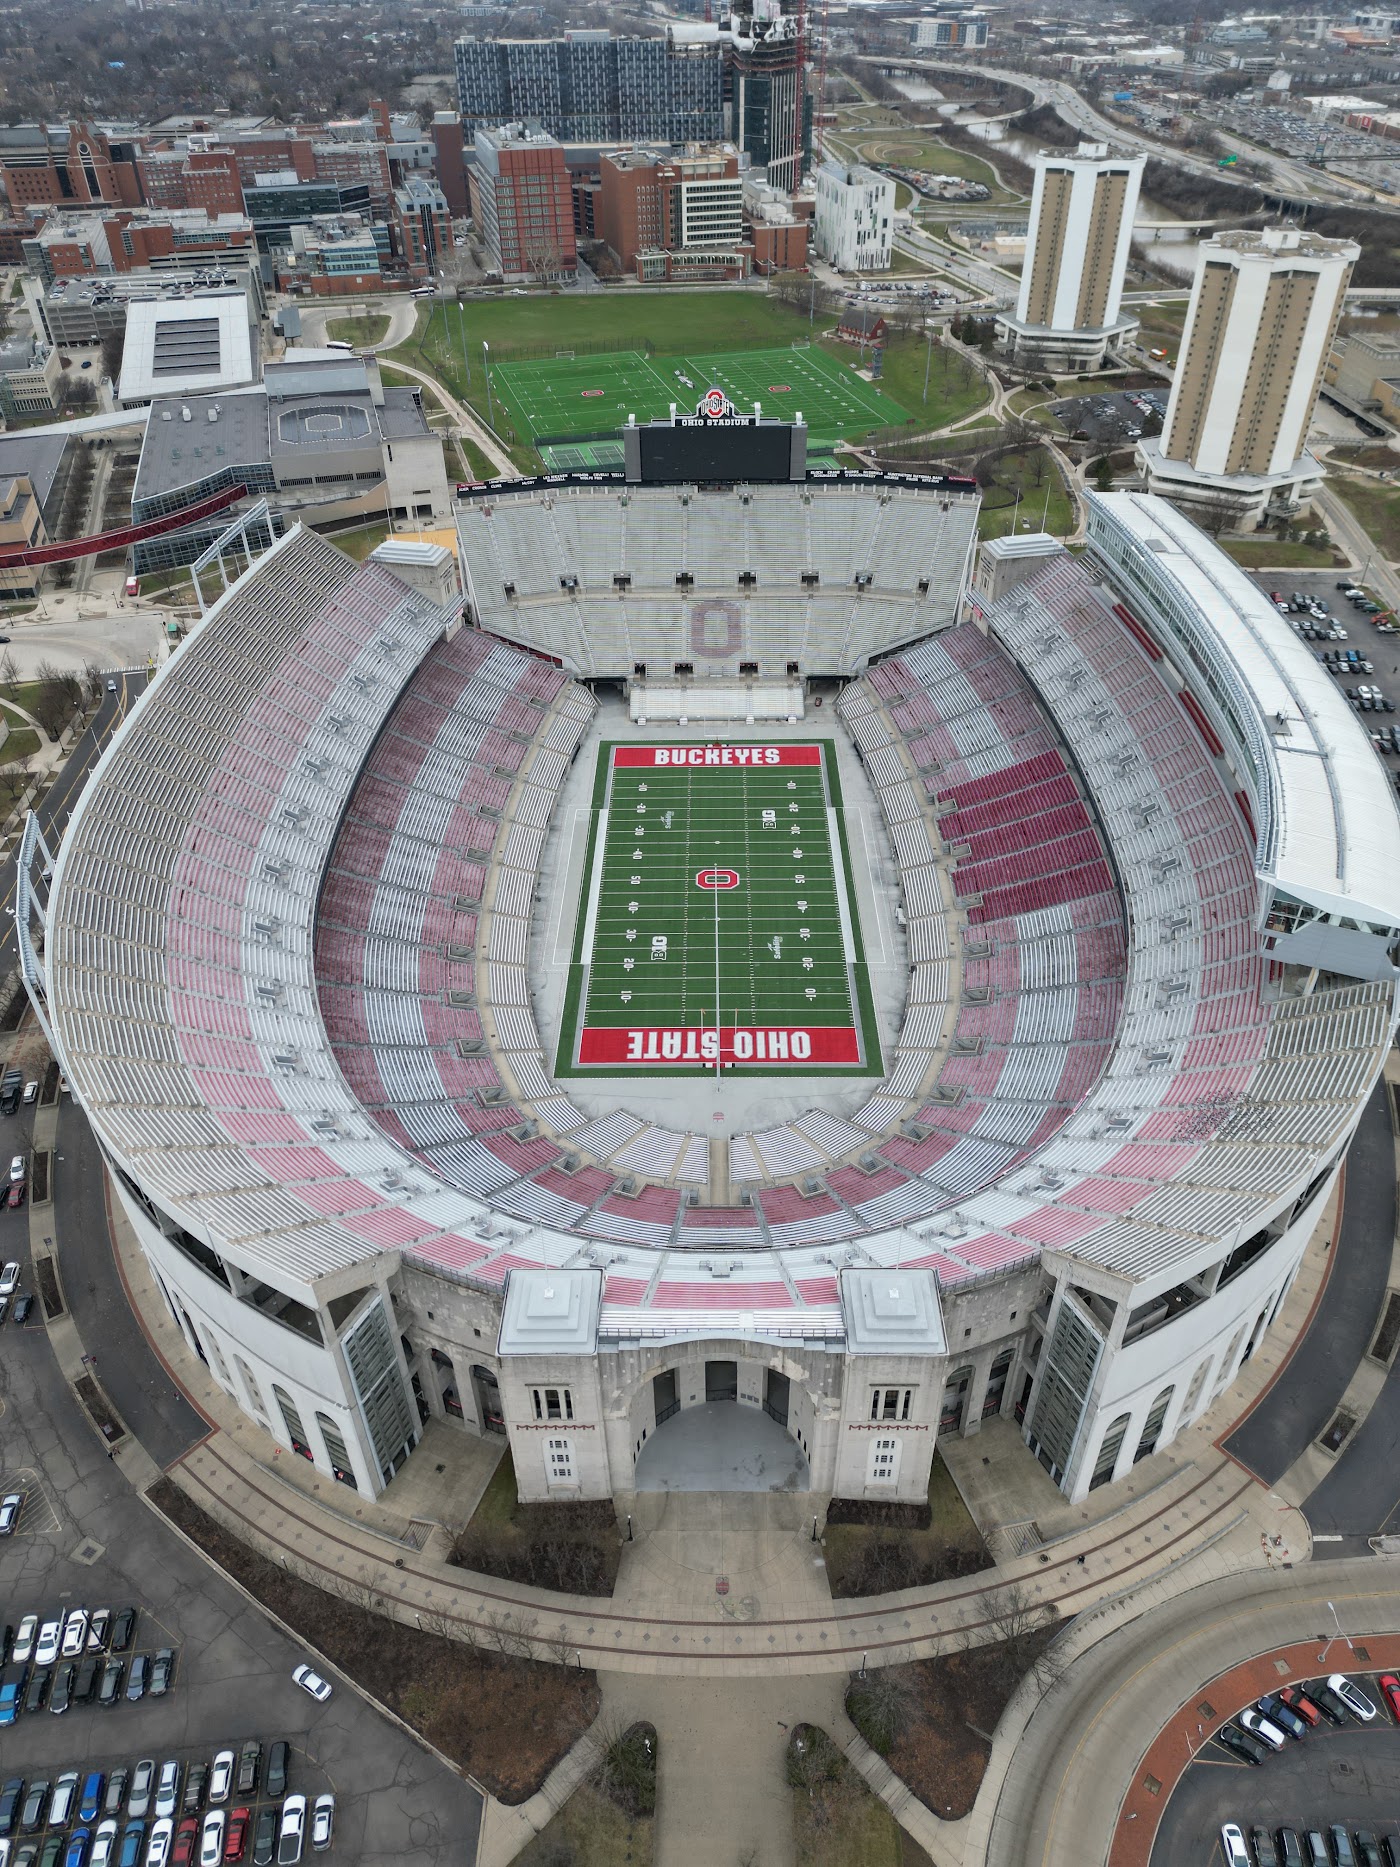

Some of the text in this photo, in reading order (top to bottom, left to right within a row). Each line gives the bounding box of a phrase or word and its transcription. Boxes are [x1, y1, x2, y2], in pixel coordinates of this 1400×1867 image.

[654, 748, 780, 765] BUCKEYES
[695, 869, 740, 890] O
[794, 874, 806, 884] 50
[626, 929, 637, 939] 30
[799, 928, 811, 938] 30
[623, 957, 635, 969] 20
[802, 957, 814, 967] 20
[620, 990, 632, 1000] 10
[804, 988, 817, 998] 10
[626, 1031, 812, 1059] OHIO STATE
